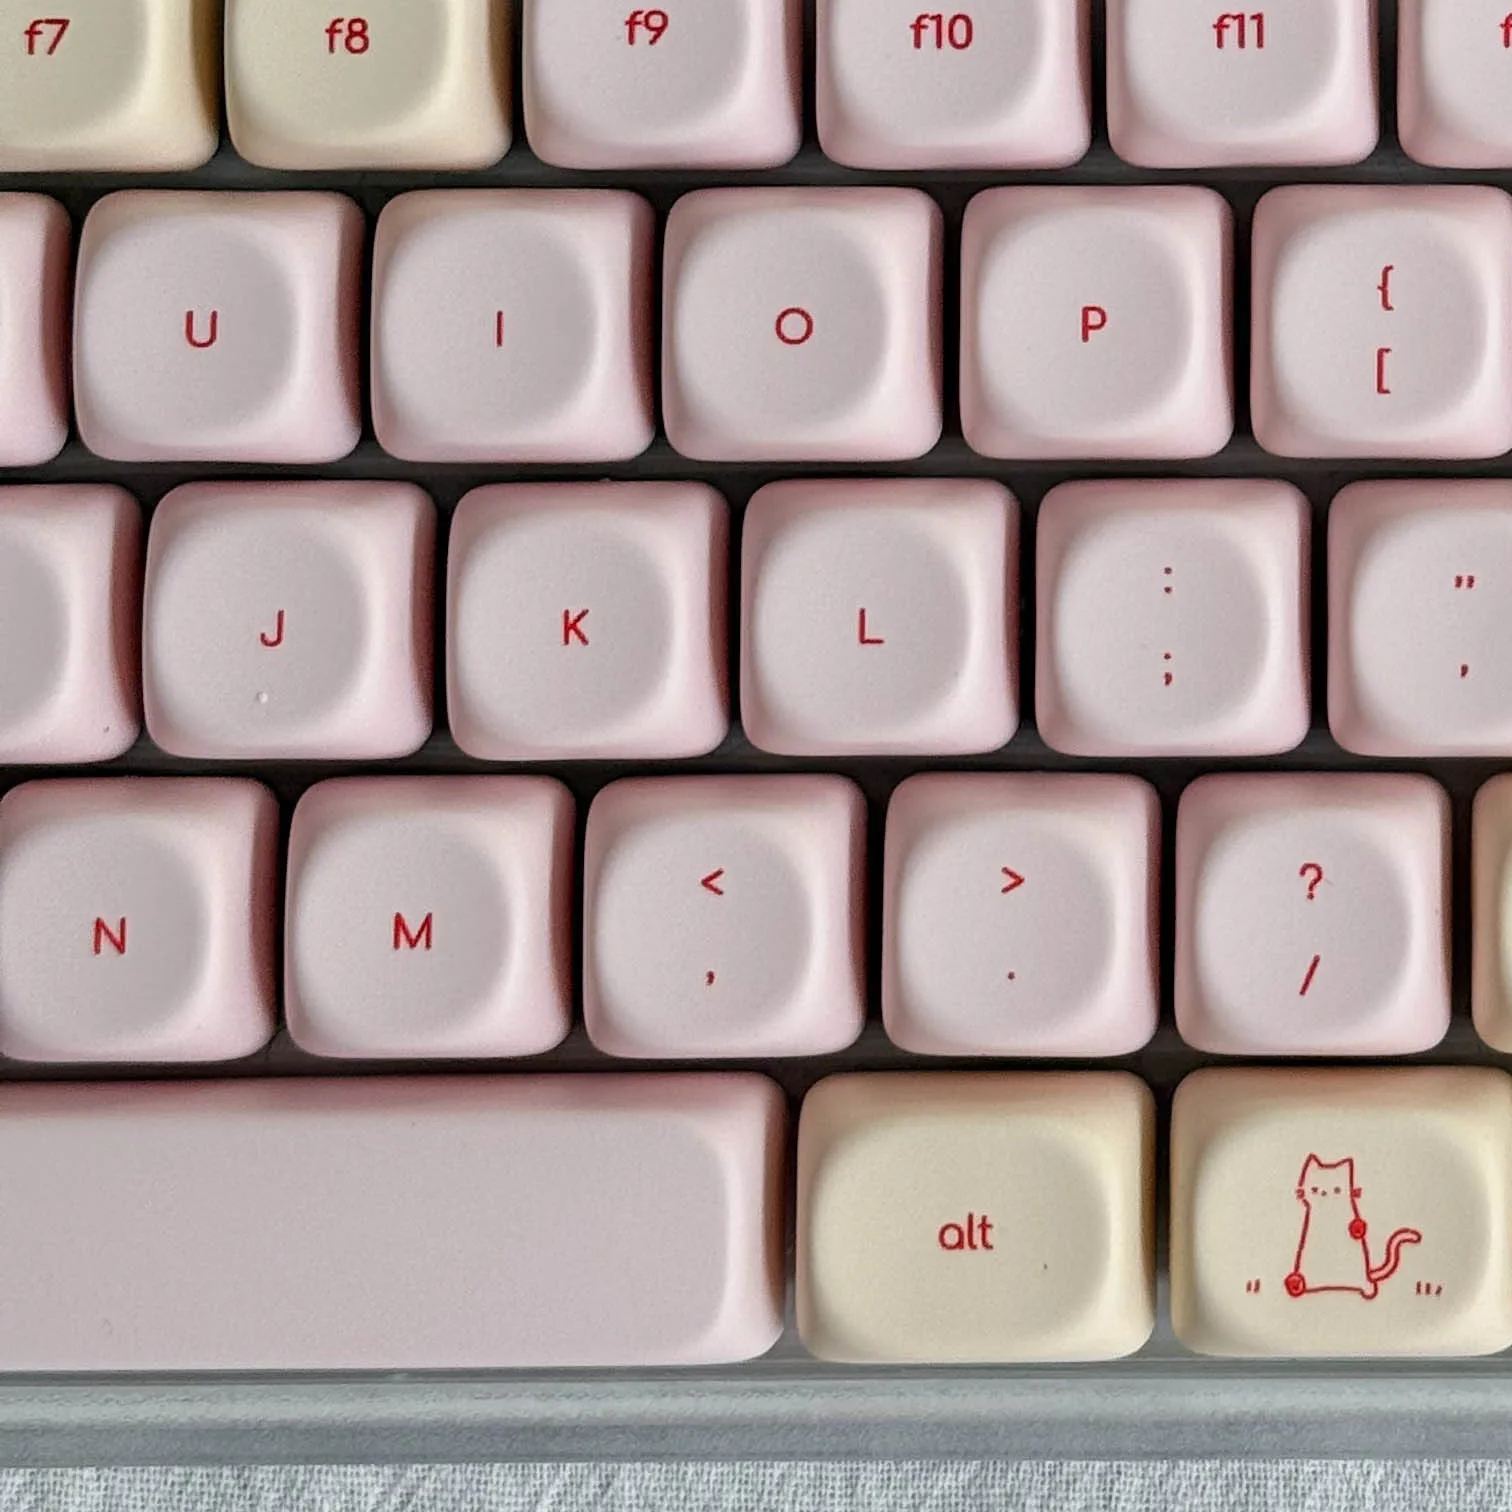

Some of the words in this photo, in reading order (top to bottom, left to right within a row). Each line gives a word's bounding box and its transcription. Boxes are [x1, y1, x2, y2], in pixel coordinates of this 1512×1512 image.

[25, 19, 70, 55] f7
[326, 18, 371, 55] f8
[626, 10, 669, 45] f9
[911, 14, 974, 51] f10
[1213, 13, 1266, 49] f11
[1377, 265, 1394, 311] {
[185, 311, 219, 349] U
[774, 307, 815, 346] O
[1081, 305, 1109, 343] P
[1376, 347, 1391, 395] [
[1163, 566, 1174, 595] :
[260, 610, 286, 648] J
[562, 610, 590, 646] K
[857, 607, 884, 646] L
[1163, 652, 1175, 687] ;
[701, 867, 725, 896] <
[1001, 866, 1026, 895] >
[1299, 862, 1325, 900] ?
[93, 918, 128, 955] N
[392, 913, 433, 951] M
[938, 1212, 994, 1252] alt
